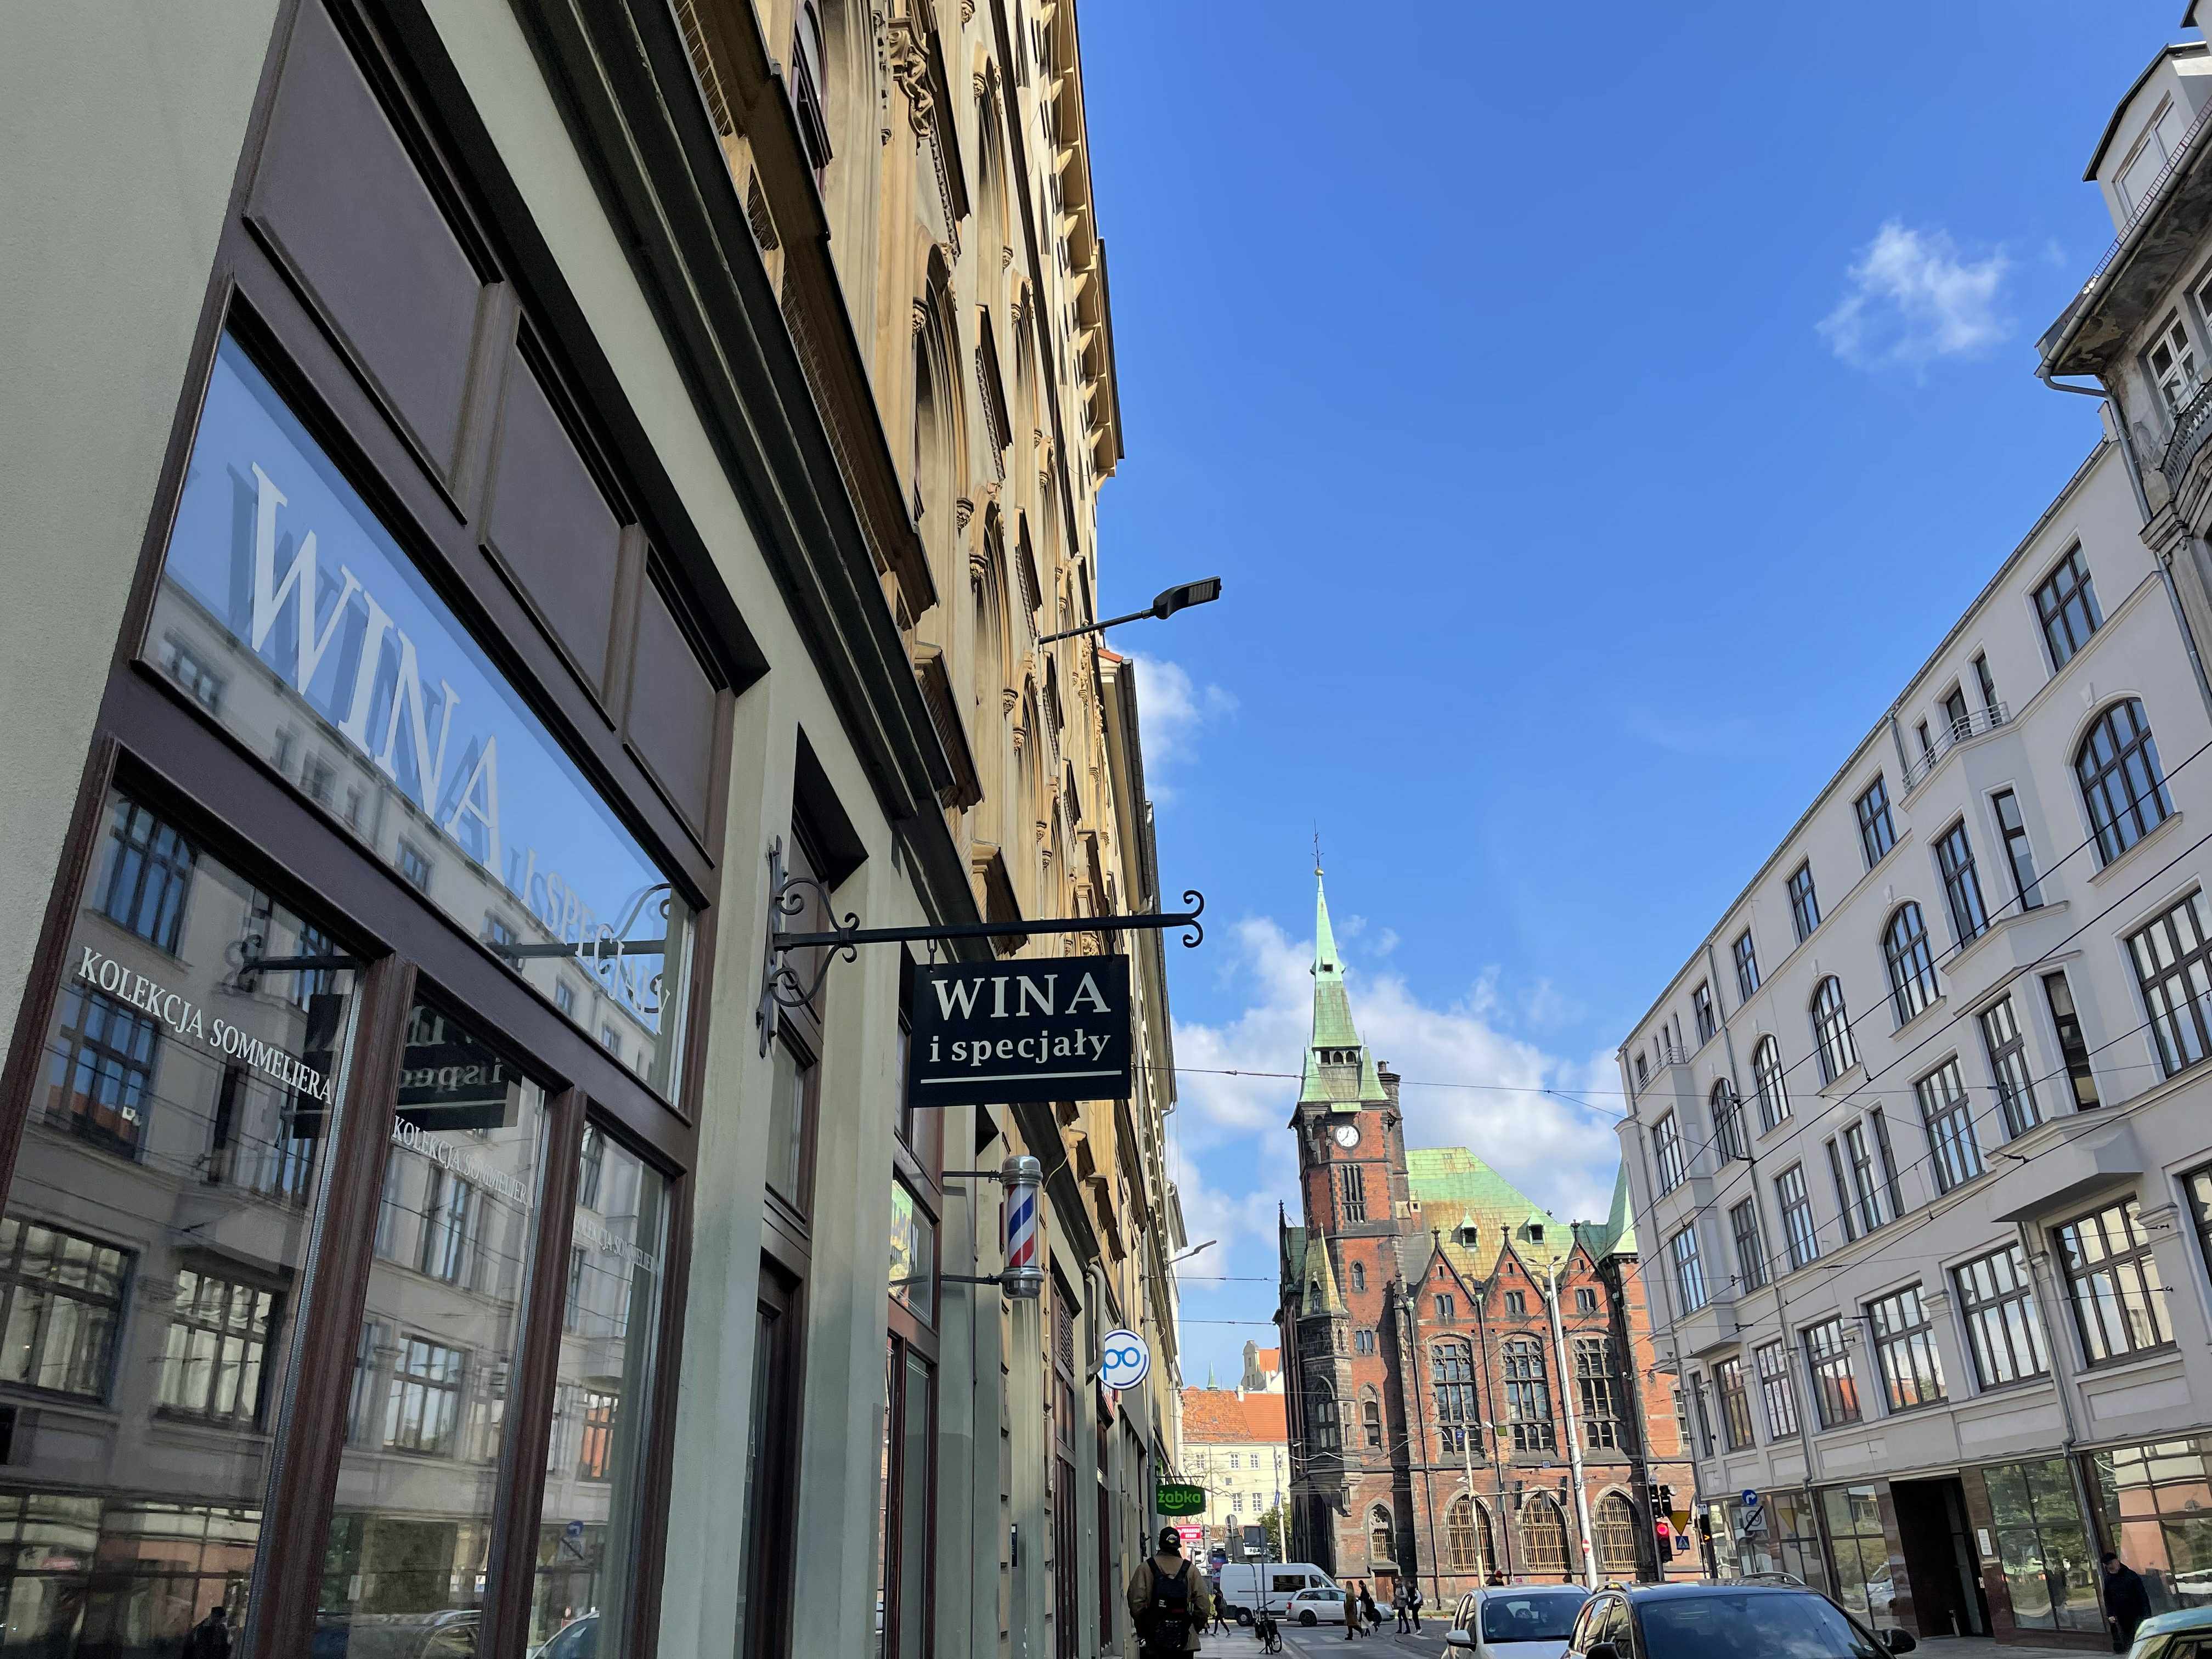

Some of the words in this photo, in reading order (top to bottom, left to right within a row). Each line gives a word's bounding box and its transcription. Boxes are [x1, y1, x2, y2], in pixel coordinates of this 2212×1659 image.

[251, 461, 505, 887] WINA
[932, 972, 1110, 1021] WINA
[78, 947, 204, 1039] KOLEKCJA
[210, 1018, 332, 1104] SOMMELIERA
[929, 1035, 940, 1062] i
[951, 1029, 1111, 1066] specjały
[392, 1115, 460, 1171] KOLEKCJA
[1158, 1490, 1201, 1504] żabka
